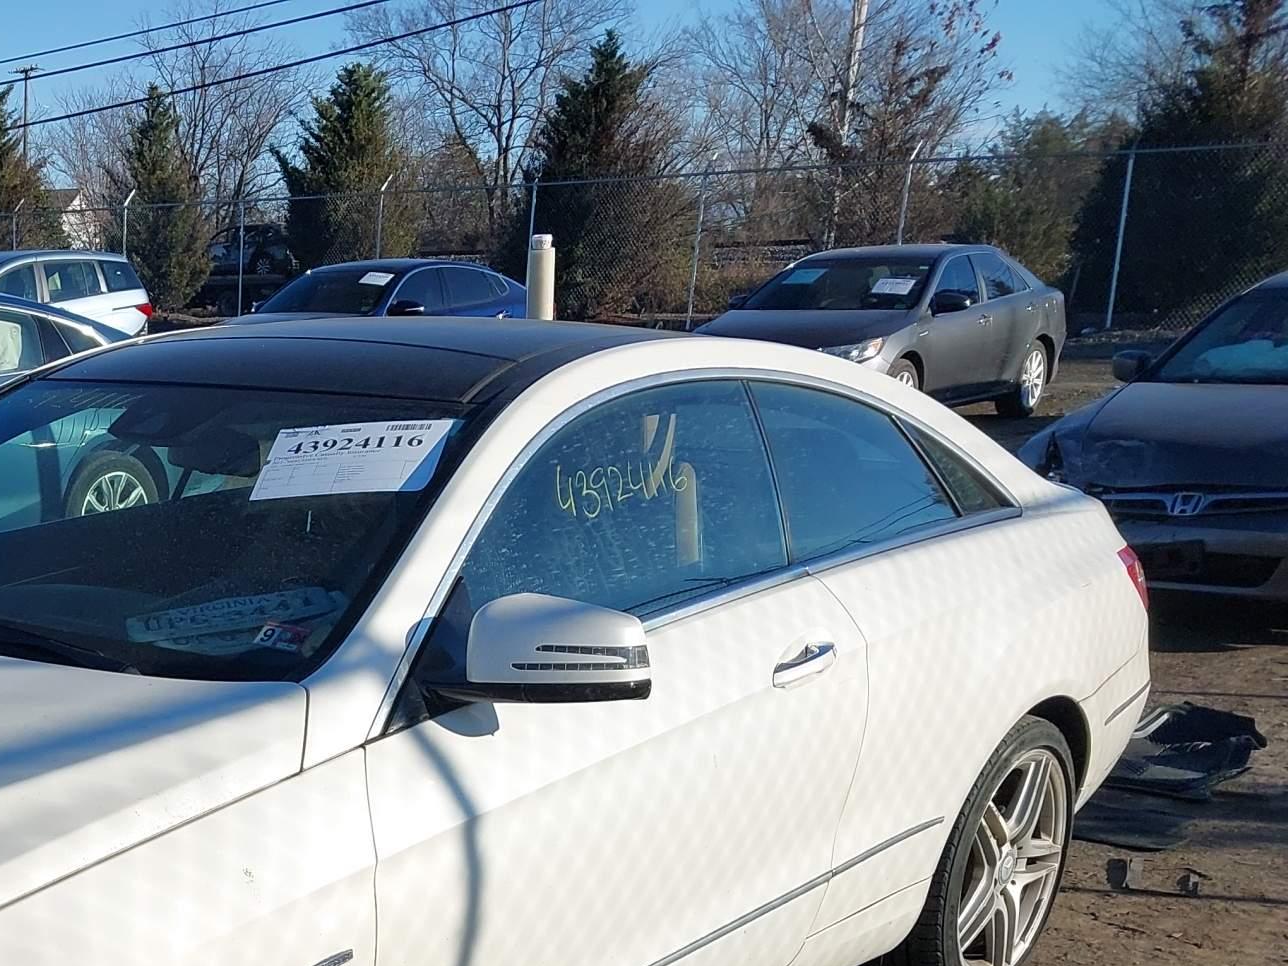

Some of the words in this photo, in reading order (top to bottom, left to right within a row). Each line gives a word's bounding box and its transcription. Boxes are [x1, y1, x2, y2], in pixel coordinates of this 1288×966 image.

[287, 434, 424, 455] 43924116
[555, 456, 688, 518] 43924116
[176, 596, 272, 617] VIRGINIA
